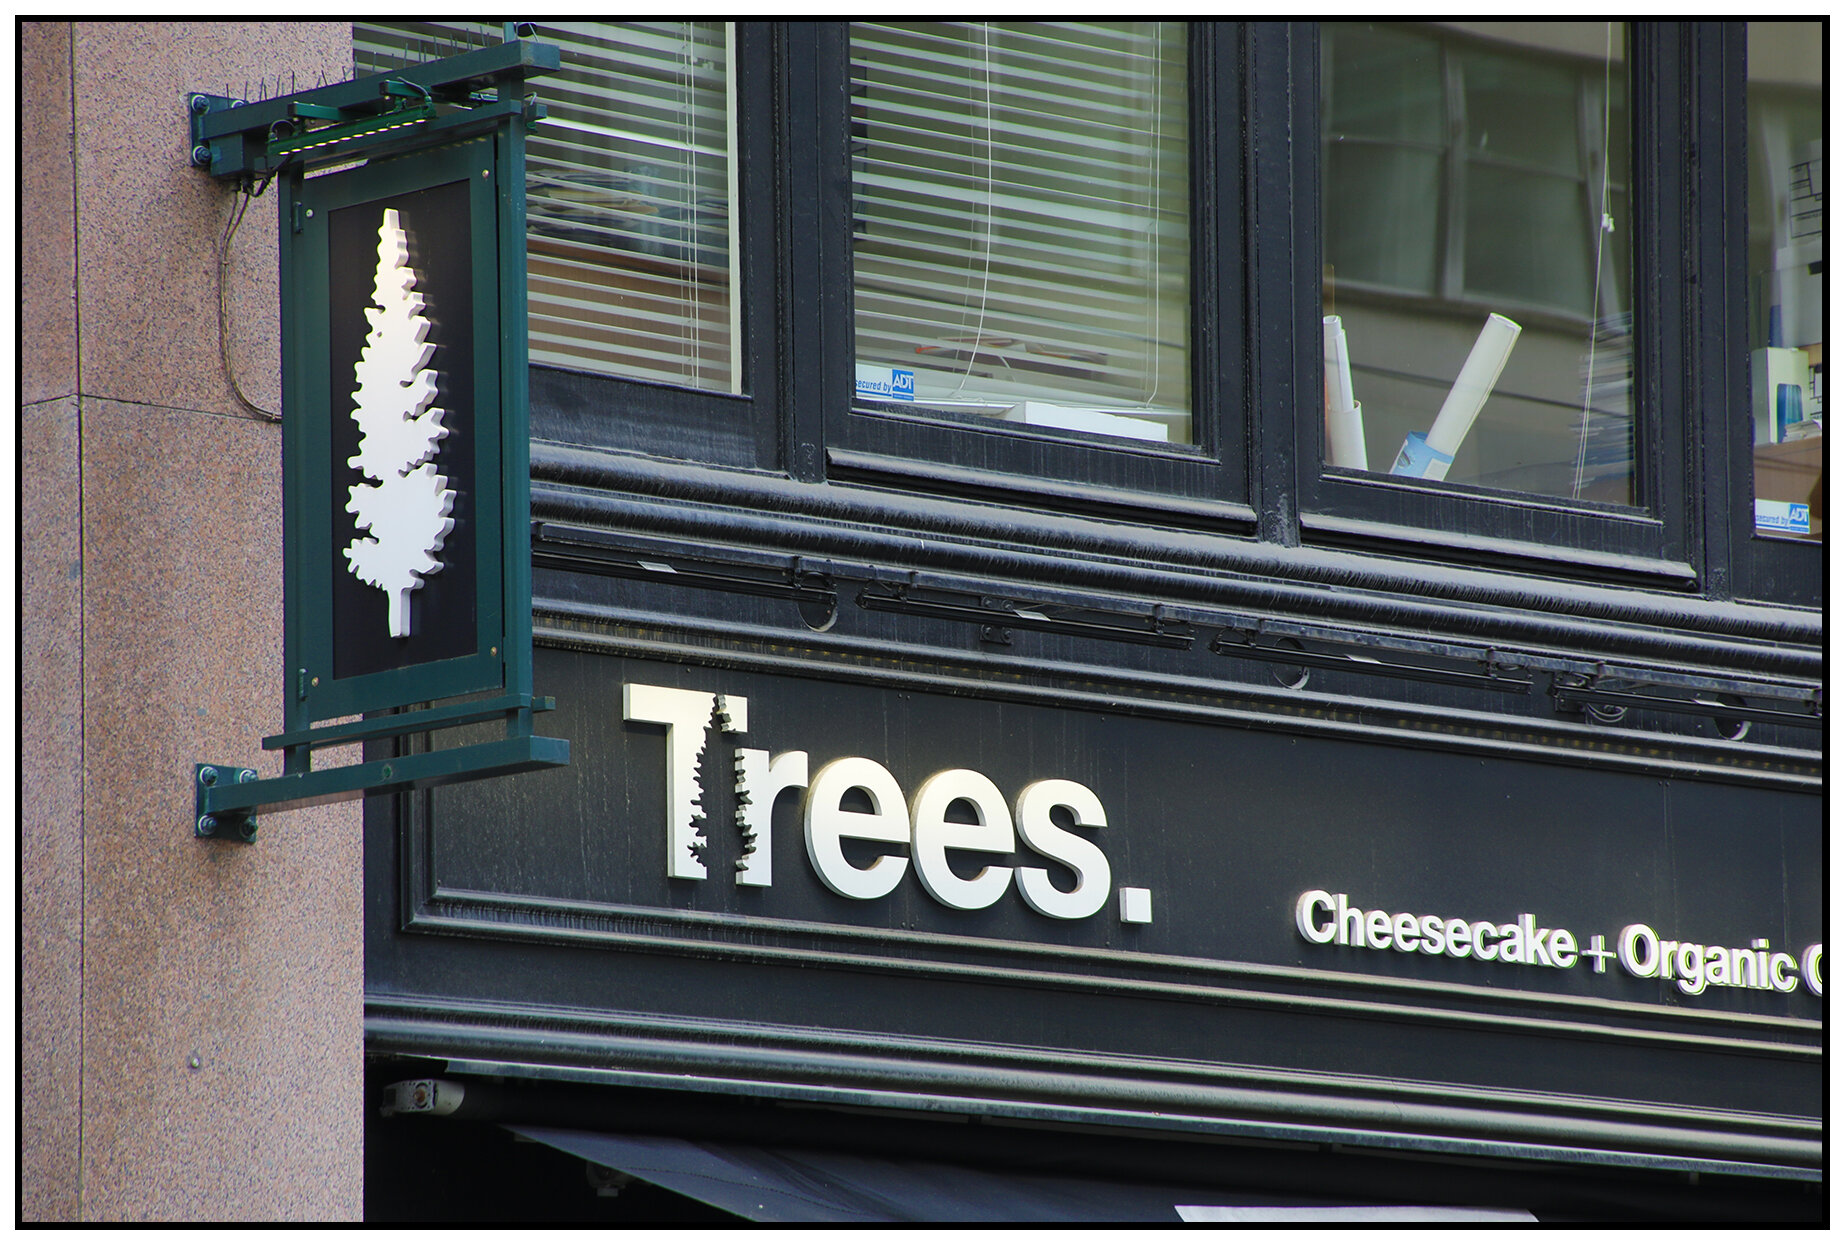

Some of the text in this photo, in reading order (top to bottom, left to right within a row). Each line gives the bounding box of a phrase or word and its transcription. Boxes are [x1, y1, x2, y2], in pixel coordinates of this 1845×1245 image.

[883, 382, 892, 393] by
[892, 373, 914, 390] ADT
[1790, 508, 1810, 522] ADT
[623, 683, 1152, 924] Trees.
[1296, 889, 1579, 968] Cheesecake
[1581, 935, 1617, 974] +
[1618, 923, 1799, 995] Organic
